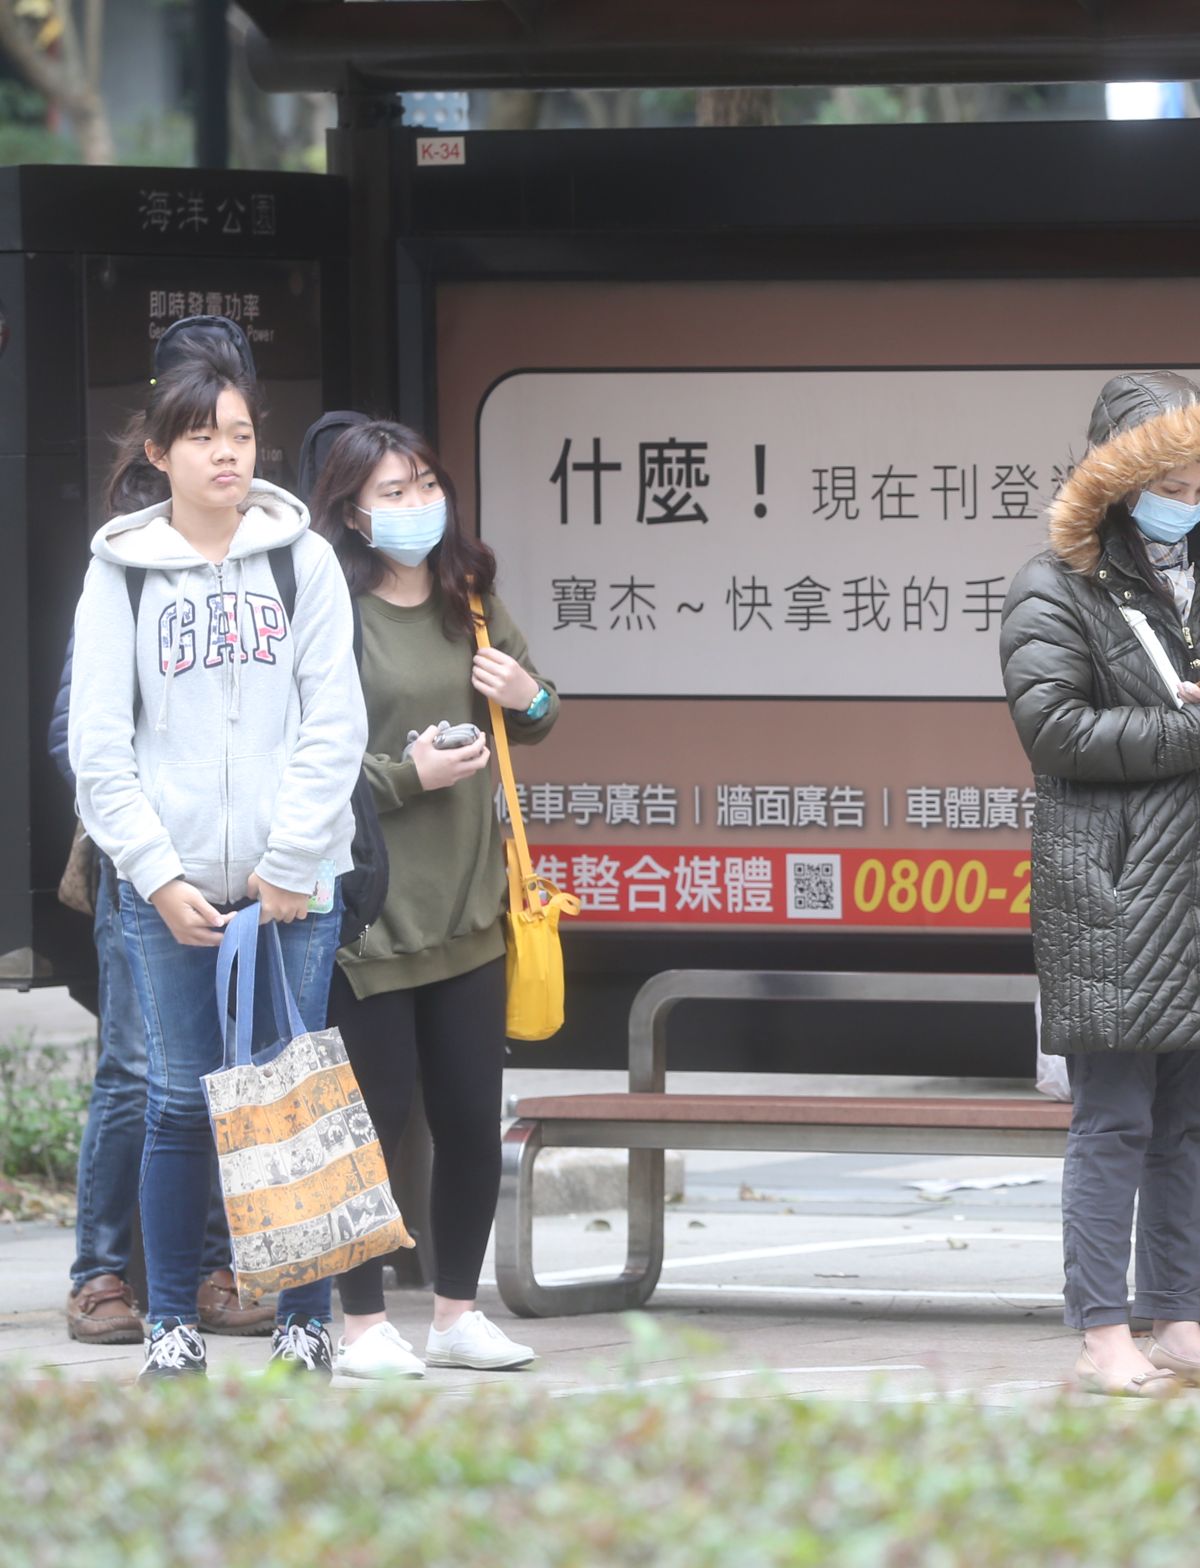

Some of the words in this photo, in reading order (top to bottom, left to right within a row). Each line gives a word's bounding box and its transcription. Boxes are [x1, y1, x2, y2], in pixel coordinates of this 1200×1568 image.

[421, 143, 461, 160] K-34
[138, 188, 276, 235] 海洋公園
[150, 291, 260, 321] 即時發電功率
[811, 463, 1076, 521] 現在刊登
[158, 591, 288, 678] GAP
